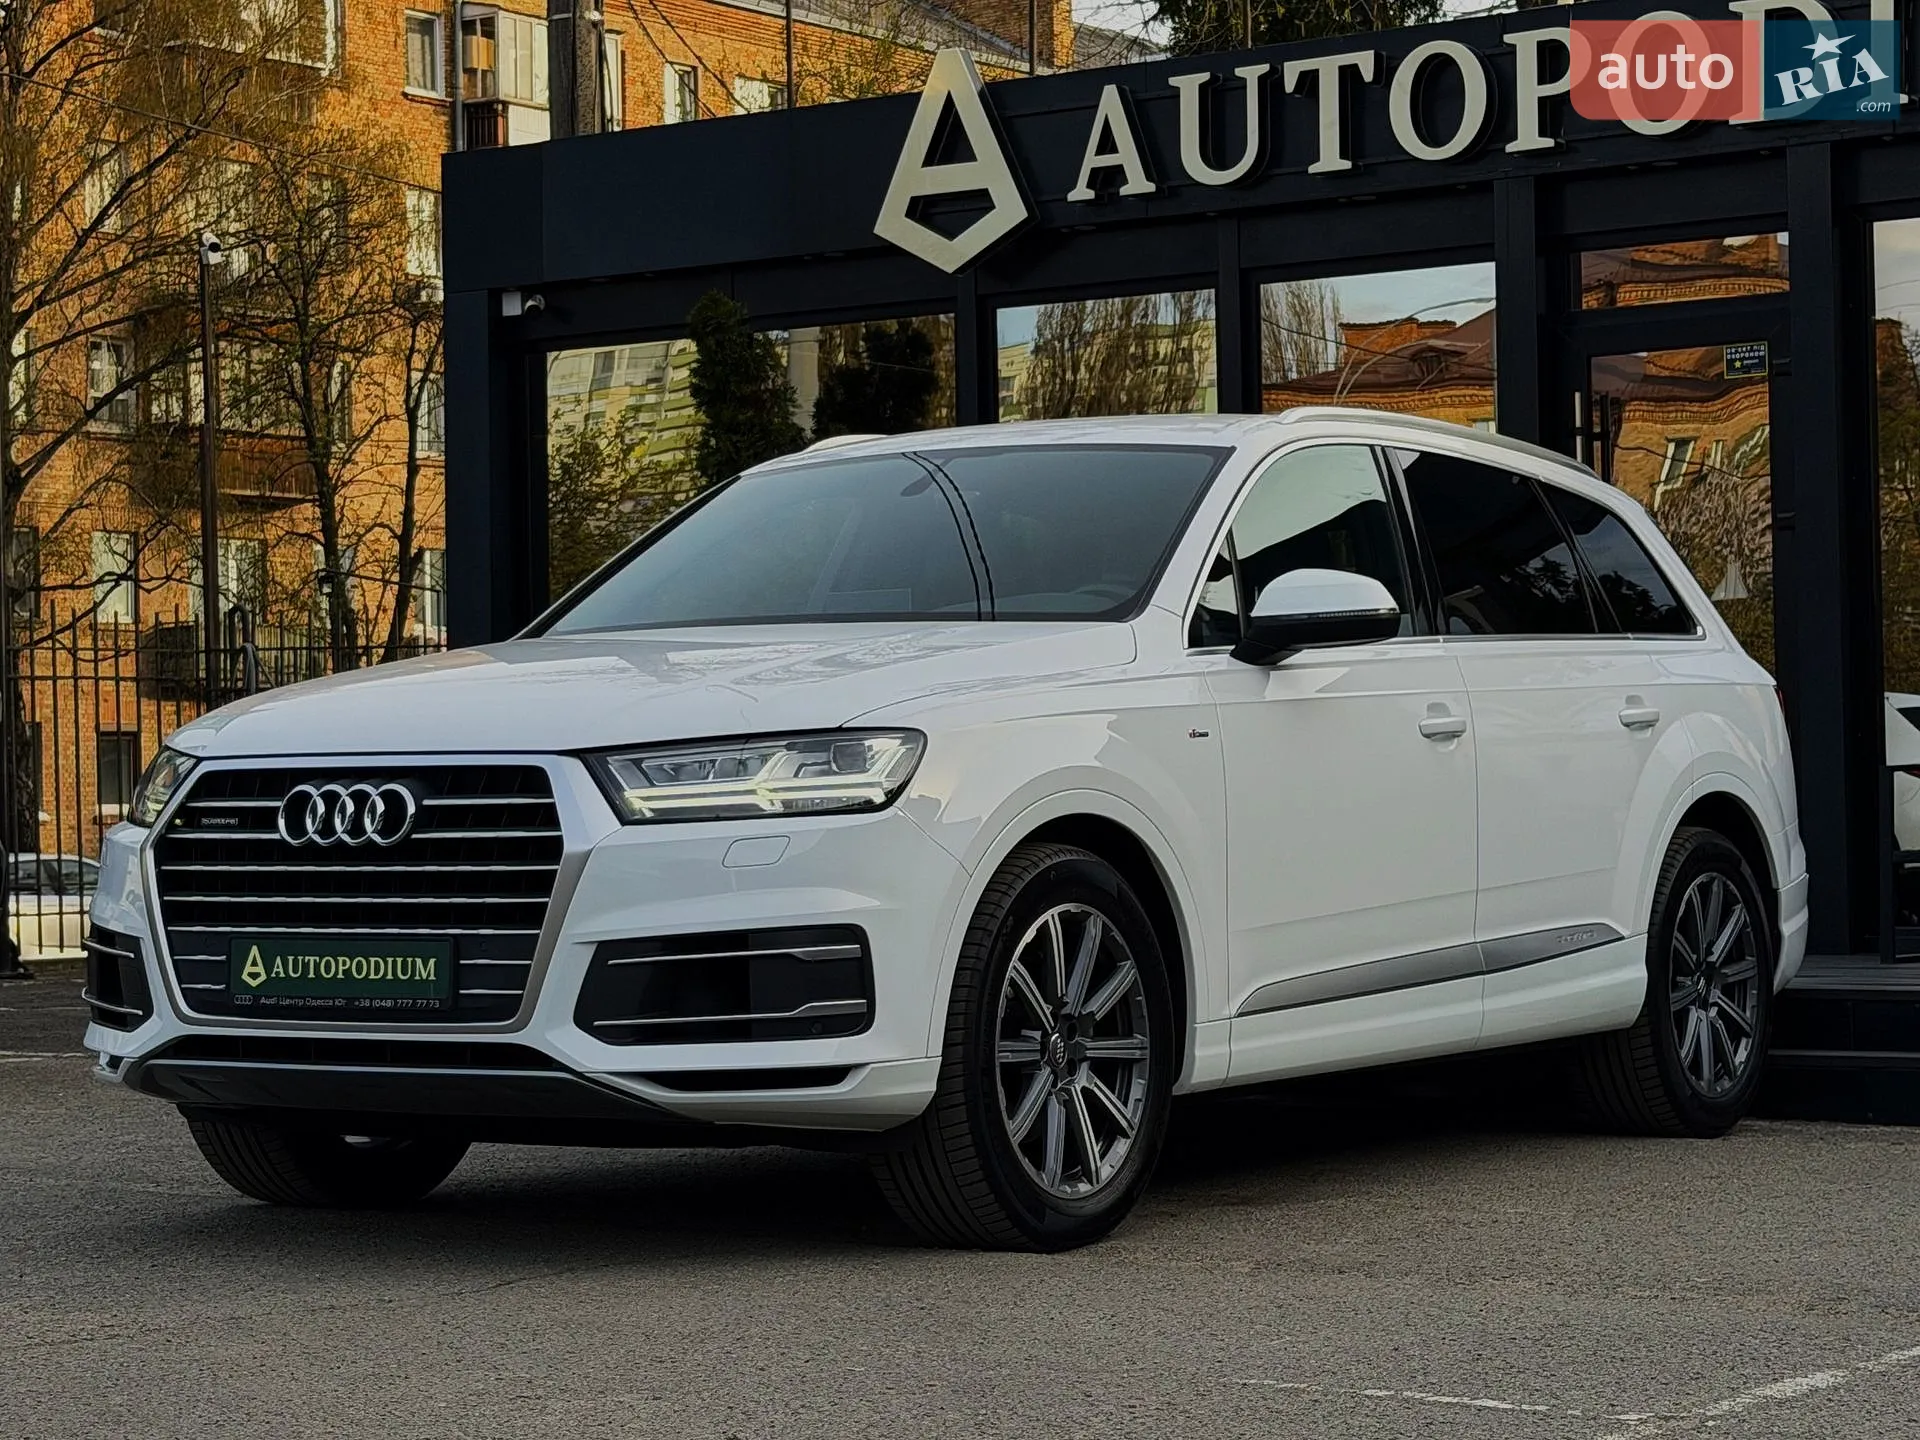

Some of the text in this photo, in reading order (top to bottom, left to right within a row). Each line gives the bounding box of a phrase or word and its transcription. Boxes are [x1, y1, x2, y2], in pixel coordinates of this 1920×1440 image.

[271, 955, 437, 981] AUTOPODIUM
[260, 996, 277, 1005] Audi
[279, 997, 304, 1007] Центр
[305, 997, 333, 1007] Одесса
[396, 999, 413, 1008] 777
[416, 999, 427, 1008] 77
[429, 1000, 440, 1009] 73
